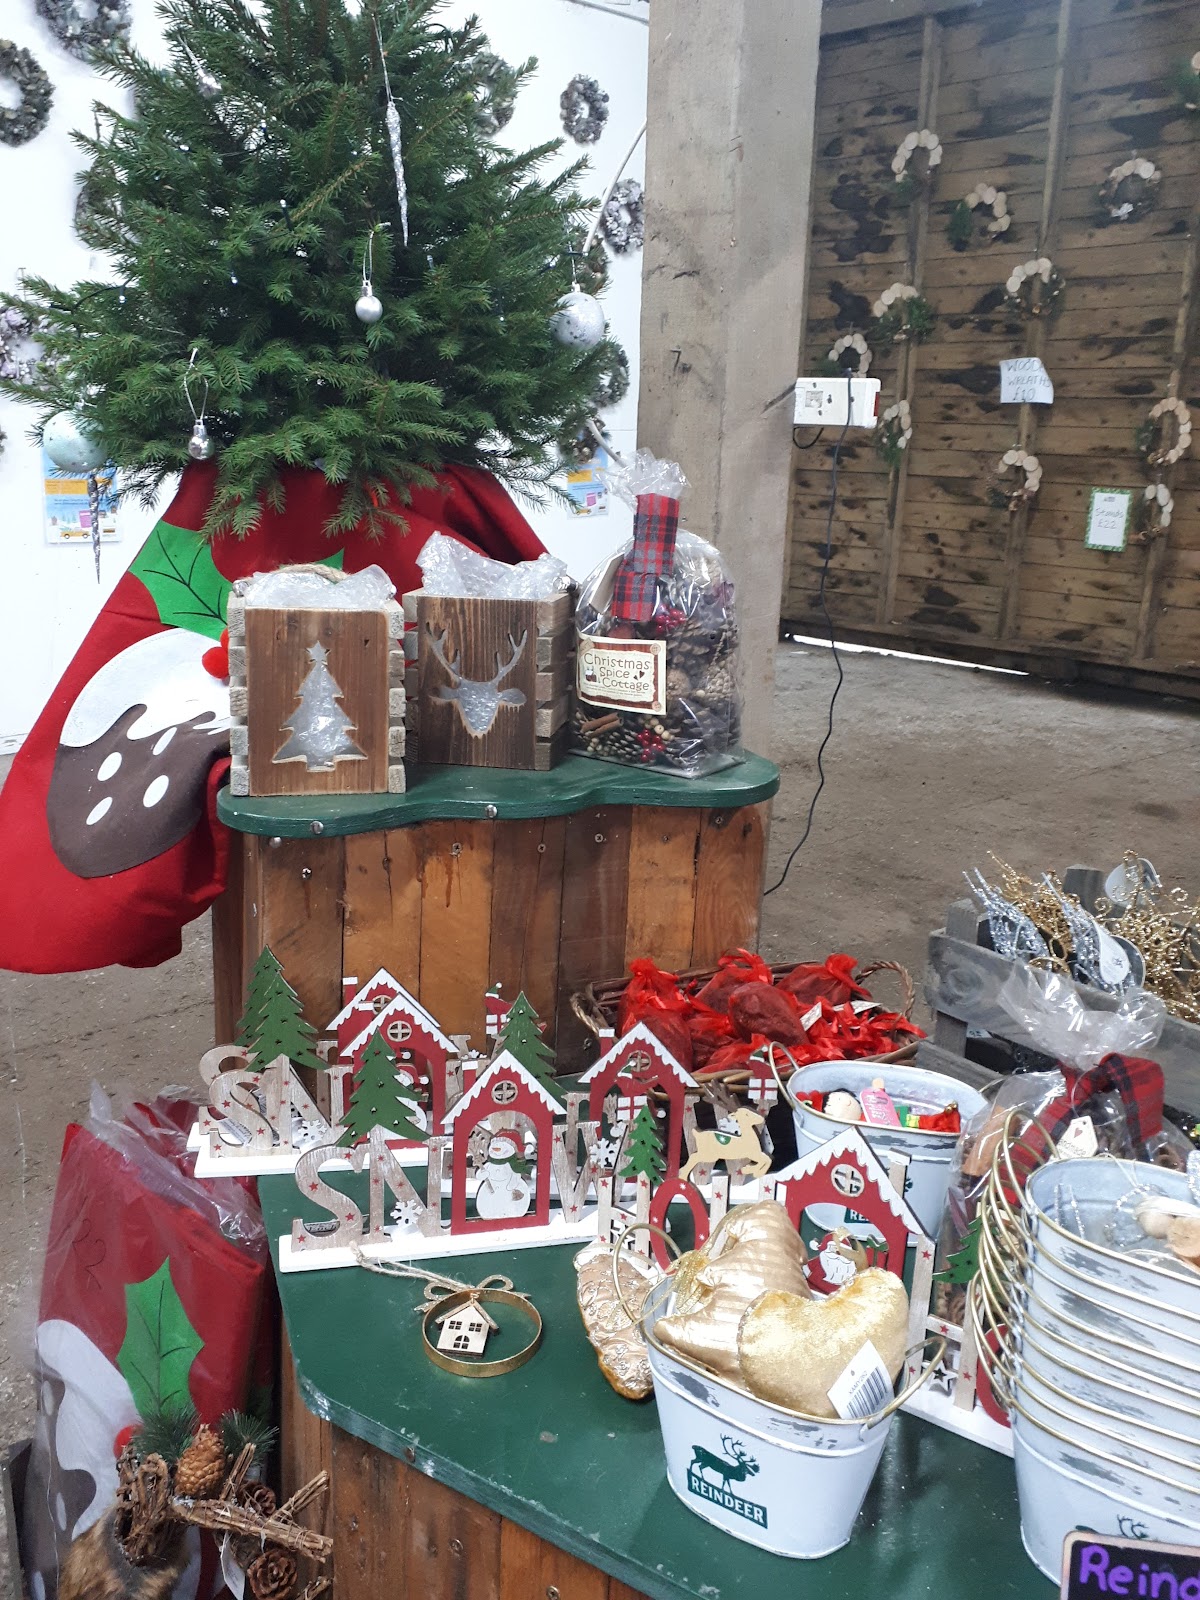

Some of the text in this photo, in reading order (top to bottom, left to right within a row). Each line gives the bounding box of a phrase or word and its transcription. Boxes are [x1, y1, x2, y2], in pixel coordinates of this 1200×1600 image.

[1013, 387, 1036, 401] £10
[583, 653, 651, 670] Christmas
[599, 666, 631, 680] Spice
[602, 677, 650, 692] Cottage
[690, 1475, 765, 1525] REINDEER
